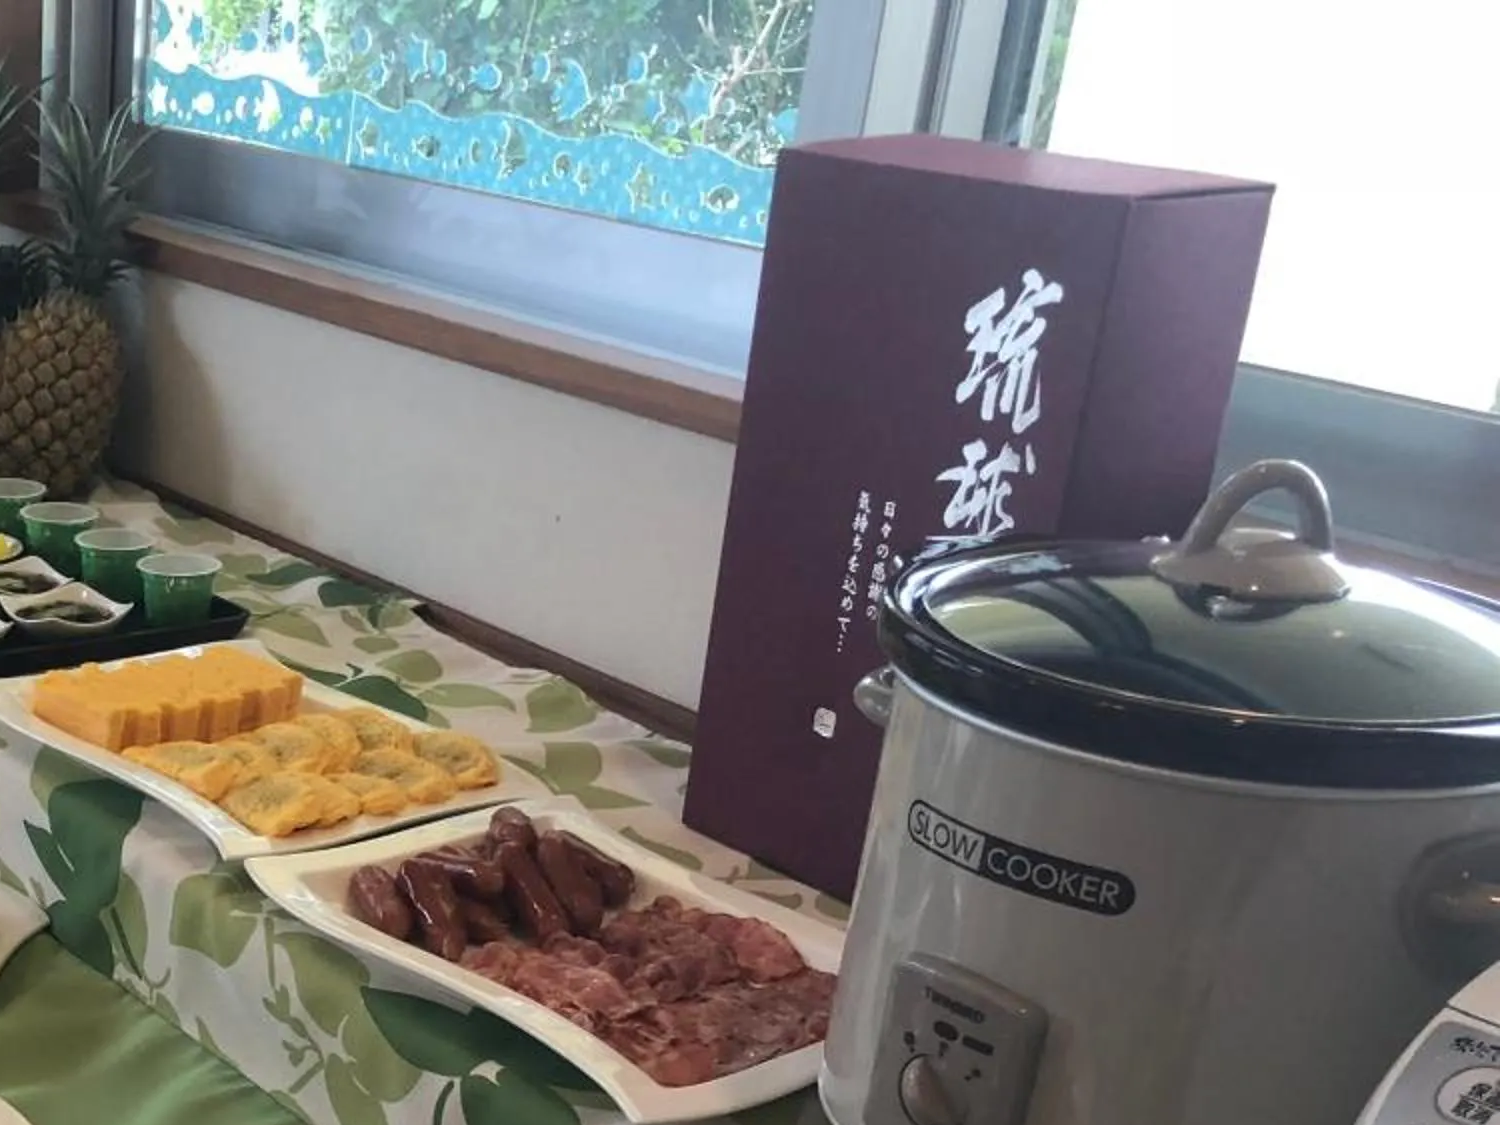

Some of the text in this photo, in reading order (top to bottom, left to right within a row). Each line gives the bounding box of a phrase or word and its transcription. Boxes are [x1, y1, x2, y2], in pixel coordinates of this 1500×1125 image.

[936, 268, 1064, 537] 琉球
[913, 810, 1120, 909] SLOW COOKER
